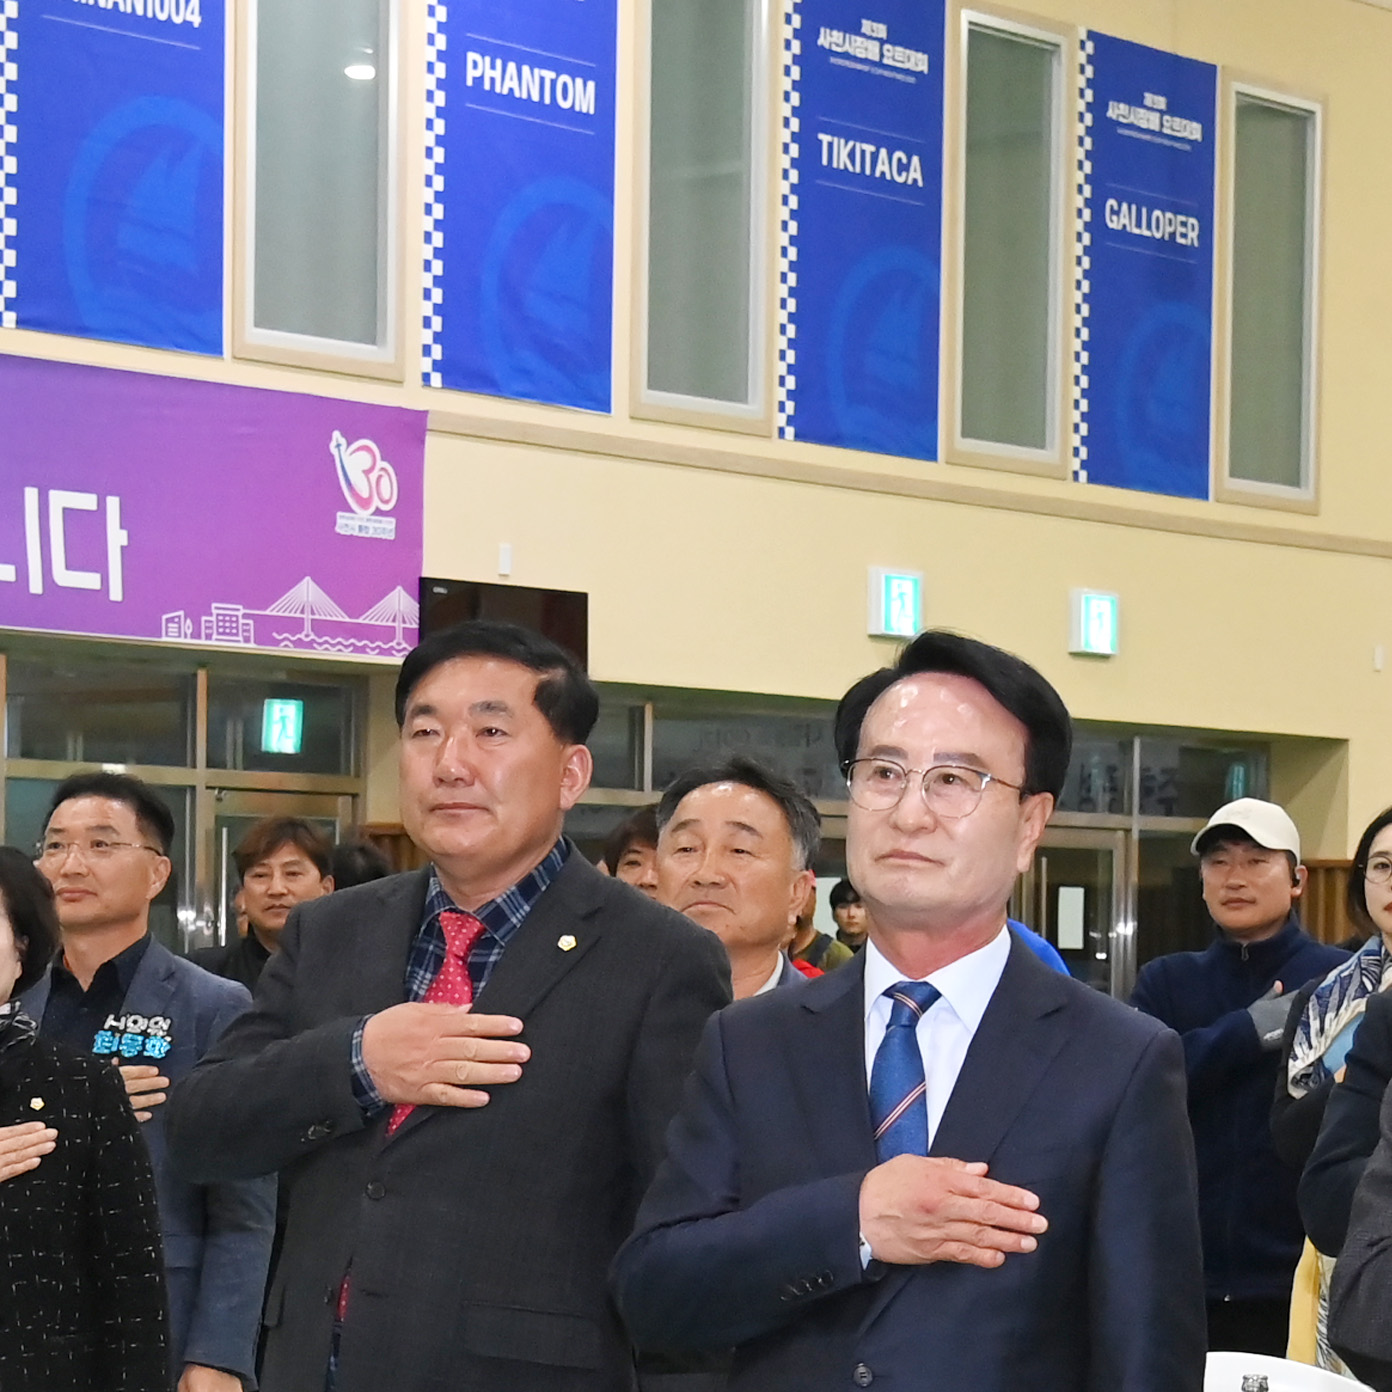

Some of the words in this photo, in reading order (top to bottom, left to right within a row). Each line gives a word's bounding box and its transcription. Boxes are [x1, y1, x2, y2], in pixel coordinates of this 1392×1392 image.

[466, 51, 596, 115] PHANTOM
[816, 132, 924, 188] TIKITACA
[1104, 198, 1200, 248] GALLOPER
